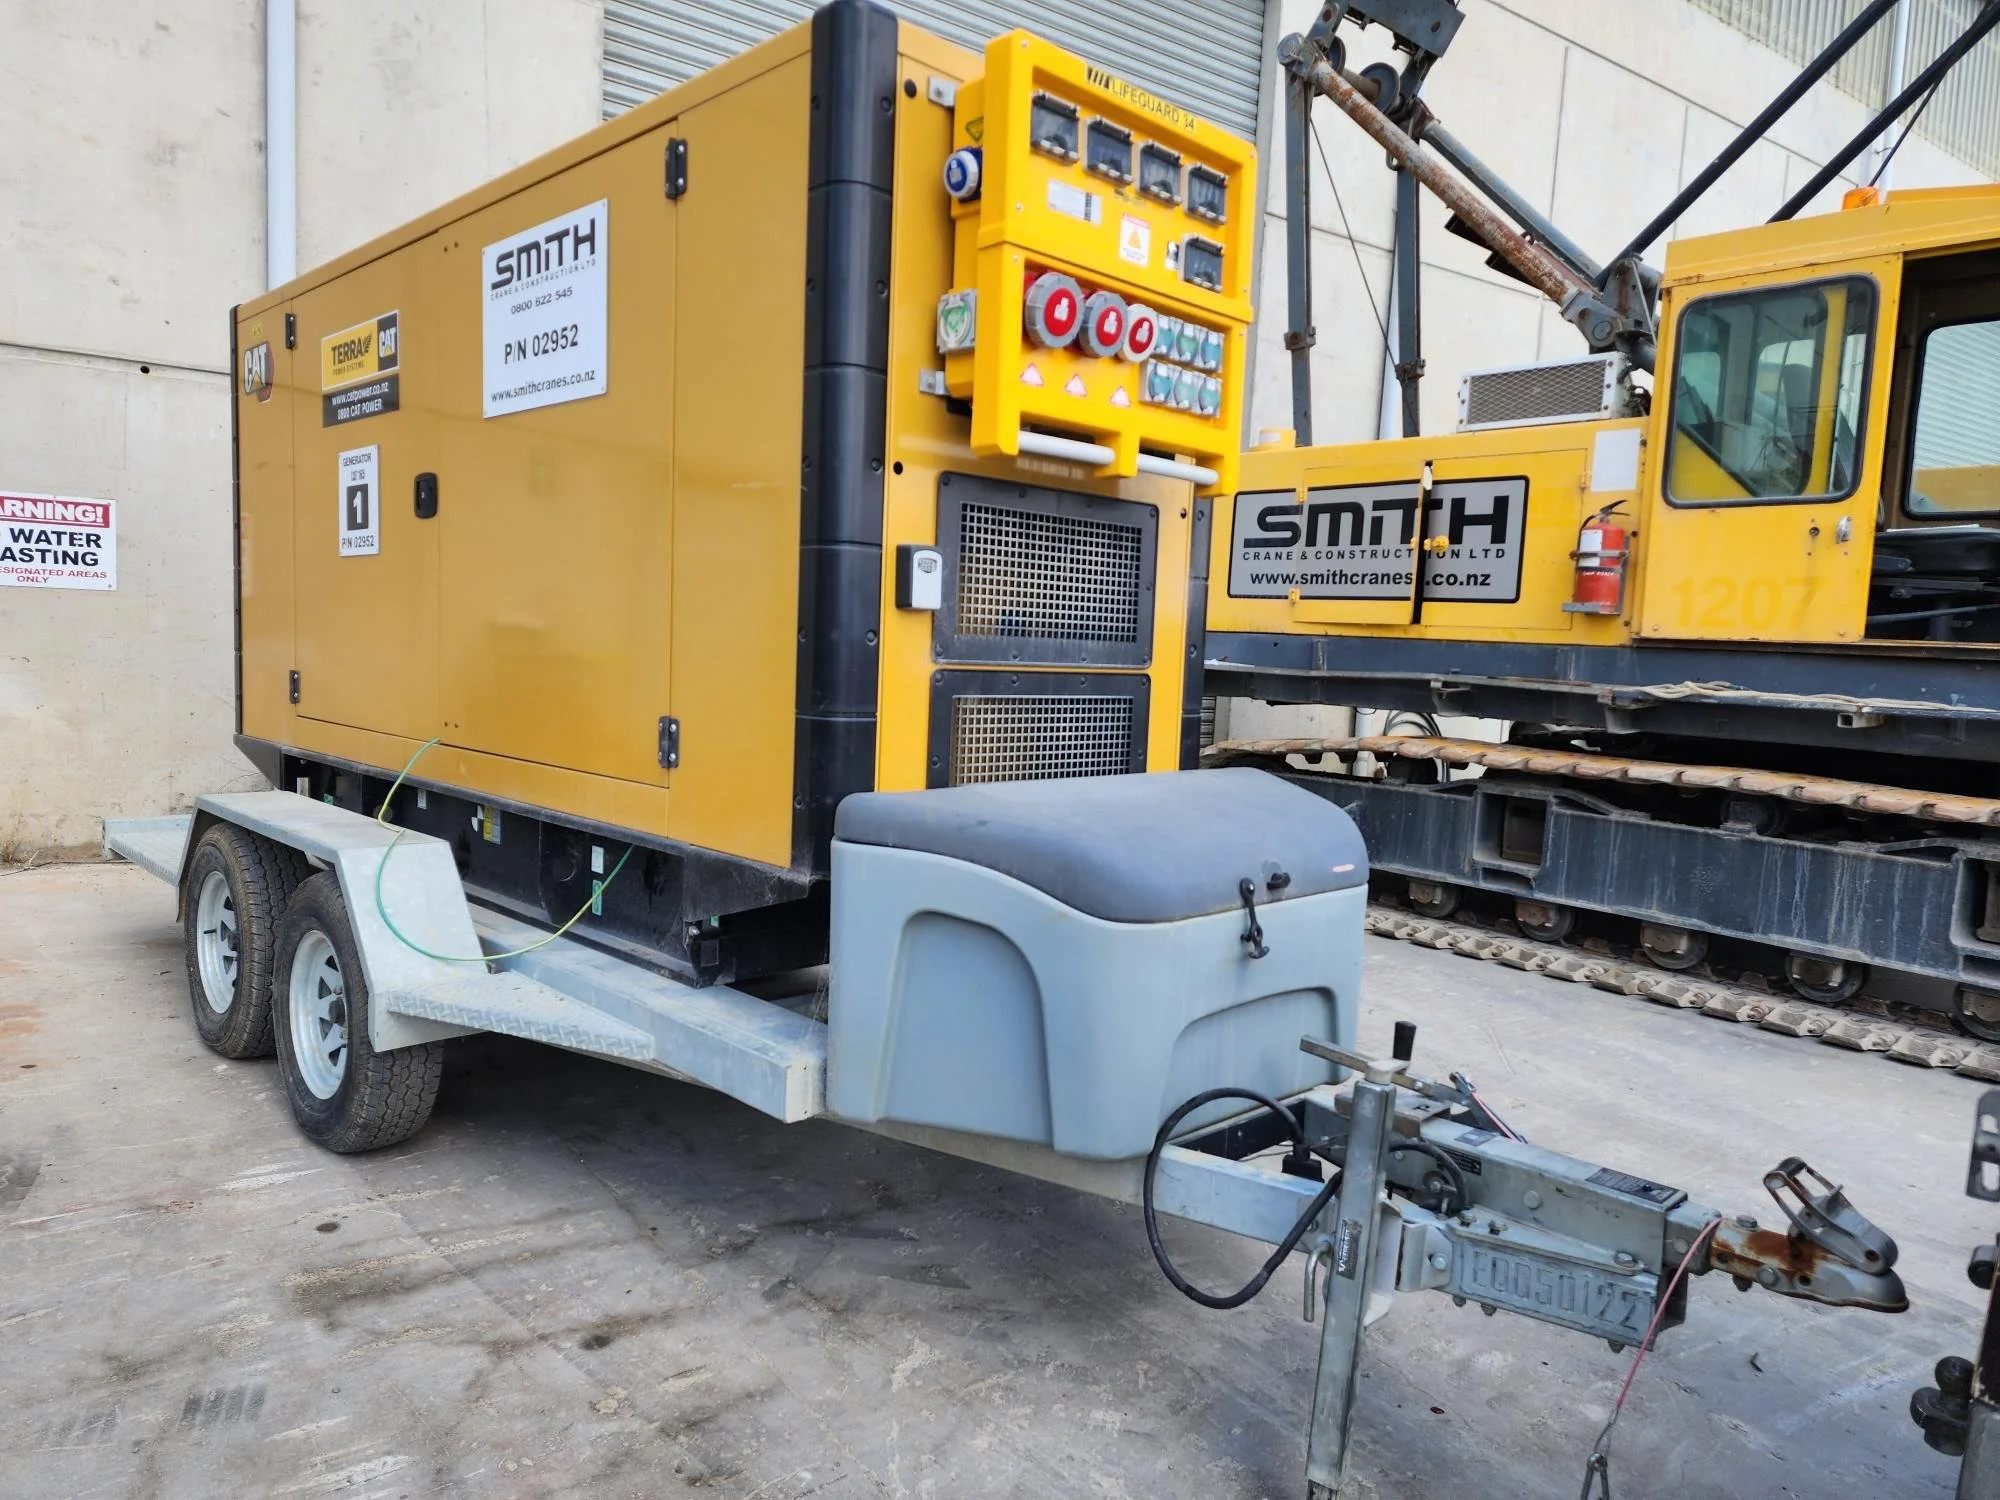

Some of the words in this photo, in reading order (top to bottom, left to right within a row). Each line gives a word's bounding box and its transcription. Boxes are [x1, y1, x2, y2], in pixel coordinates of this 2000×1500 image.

[1112, 79, 1179, 122] LIFEGUARD
[491, 218, 596, 291] SMITH
[511, 300, 533, 315] 0800
[555, 286, 573, 300] 545
[331, 336, 363, 365] TERRA
[378, 326, 396, 358] CAT
[504, 337, 527, 365] P/N
[532, 323, 579, 357] 02952
[244, 343, 267, 393] CAT
[331, 381, 389, 407] www.catpower.co.nz
[491, 369, 595, 403] www.smithcranes.co.nz
[350, 404, 361, 417] CAT
[361, 397, 382, 414] POWER
[342, 453, 372, 467] GENERATOR
[353, 490, 362, 523] 1
[1243, 495, 1510, 549] SMITH
[9, 528, 102, 548] WATER
[354, 535, 374, 548] 02952
[1242, 550, 1293, 561] CRANE
[1300, 550, 1308, 560] &
[1469, 548, 1506, 558] LTD
[16, 575, 49, 584] ONLY
[67, 570, 107, 579] AREAS
[1250, 568, 1491, 587] www.smithcranes.co.nz
[1672, 577, 1824, 629] 1207
